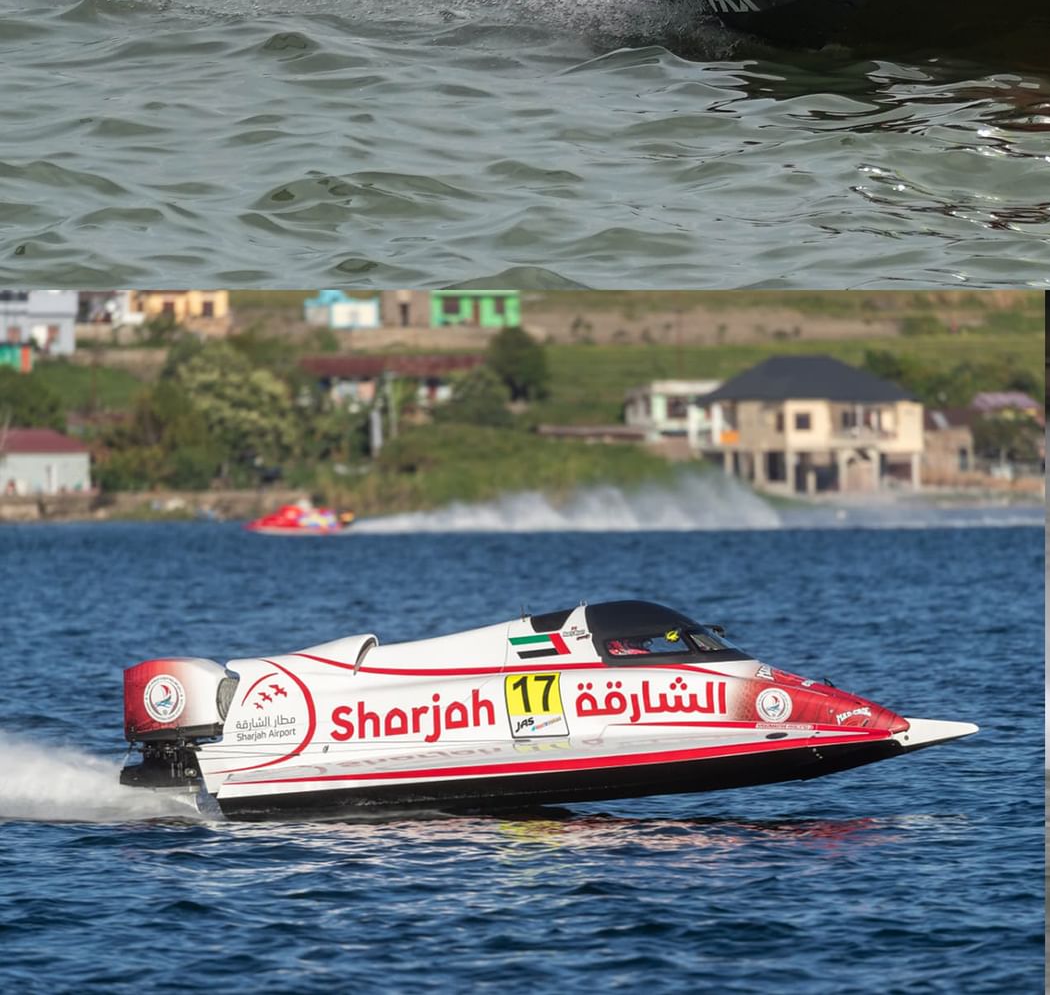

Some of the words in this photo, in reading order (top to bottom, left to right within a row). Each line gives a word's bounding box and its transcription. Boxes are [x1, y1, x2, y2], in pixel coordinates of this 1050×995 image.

[512, 675, 556, 713] 17
[575, 676, 727, 723] الشارقة
[235, 715, 270, 731] الشارقة
[273, 714, 296, 728] مطار
[330, 689, 496, 743] Sharjah
[515, 716, 535, 733] JAS
[236, 731, 267, 742] Sharjah
[268, 728, 296, 738] Airport
